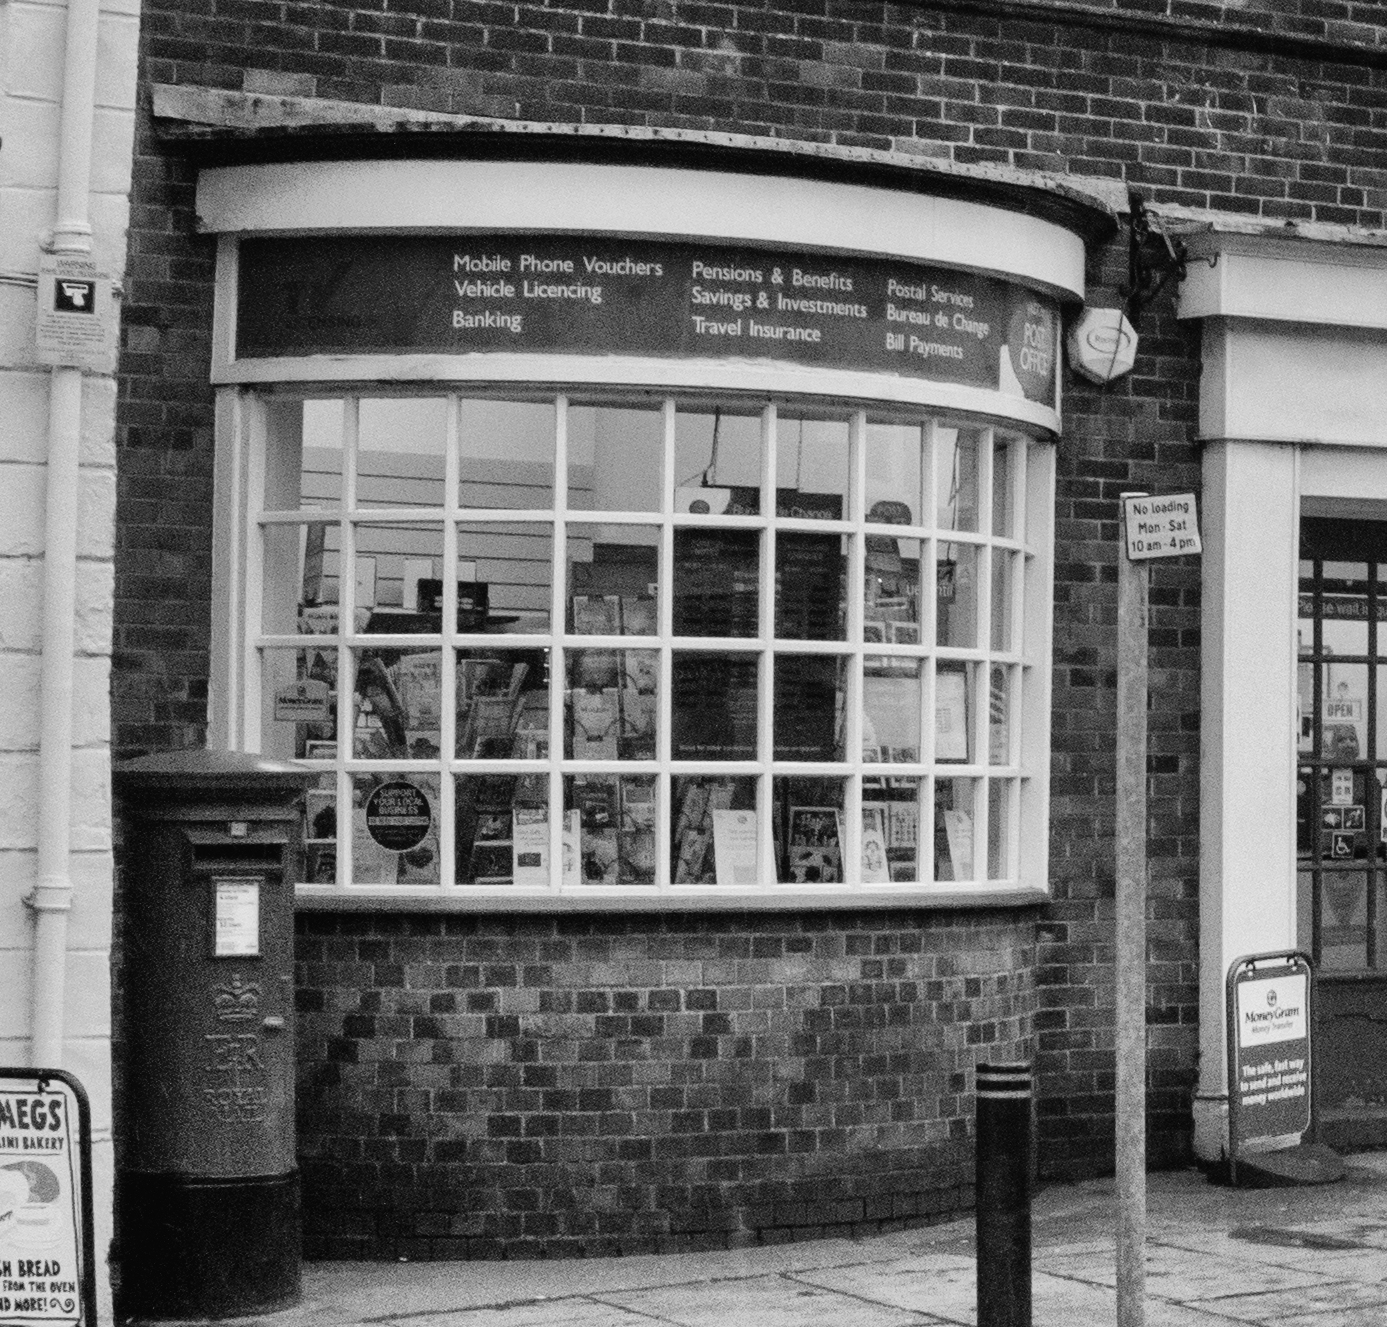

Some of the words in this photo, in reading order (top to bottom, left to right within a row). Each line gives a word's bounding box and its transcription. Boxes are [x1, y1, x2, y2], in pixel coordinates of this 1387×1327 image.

[453, 255, 511, 273] Mobile
[520, 255, 574, 273] Phone
[583, 256, 663, 276] Vouchers
[692, 261, 762, 283] Pensions
[771, 268, 784, 284] &
[792, 269, 853, 291] Benefits
[454, 279, 515, 298] Vehicle
[523, 281, 602, 304] Licencing
[887, 279, 926, 301] Postal
[931, 284, 974, 308] Services
[692, 286, 752, 311] Savings
[757, 292, 770, 309] &
[778, 292, 868, 319] Investments
[452, 310, 523, 332] Banking
[692, 316, 742, 337] Travel
[749, 320, 822, 343] Insurance
[887, 303, 930, 326] Bureau
[935, 310, 948, 328] de
[953, 313, 990, 339] Change
[886, 333, 905, 351] Bill
[909, 334, 964, 360] Payments
[1132, 503, 1148, 515] No
[1151, 501, 1190, 514] loading
[1138, 521, 1160, 535] Mon
[1168, 519, 1187, 532] Sat
[1131, 539, 1144, 552] 10
[1147, 541, 1162, 552] am
[1169, 536, 1177, 549] 4
[1179, 538, 1196, 551] pm
[1327, 704, 1353, 718] OPEN
[1245, 1006, 1300, 1024] MoneyGram
[0, 1136, 19, 1149] INI
[22, 1136, 64, 1150] BAKERY
[18, 1258, 61, 1278] BREAD
[3, 1279, 25, 1292] FROM
[29, 1281, 46, 1292] THE
[49, 1281, 76, 1293] OVEN
[14, 1297, 48, 1312] MORE!
